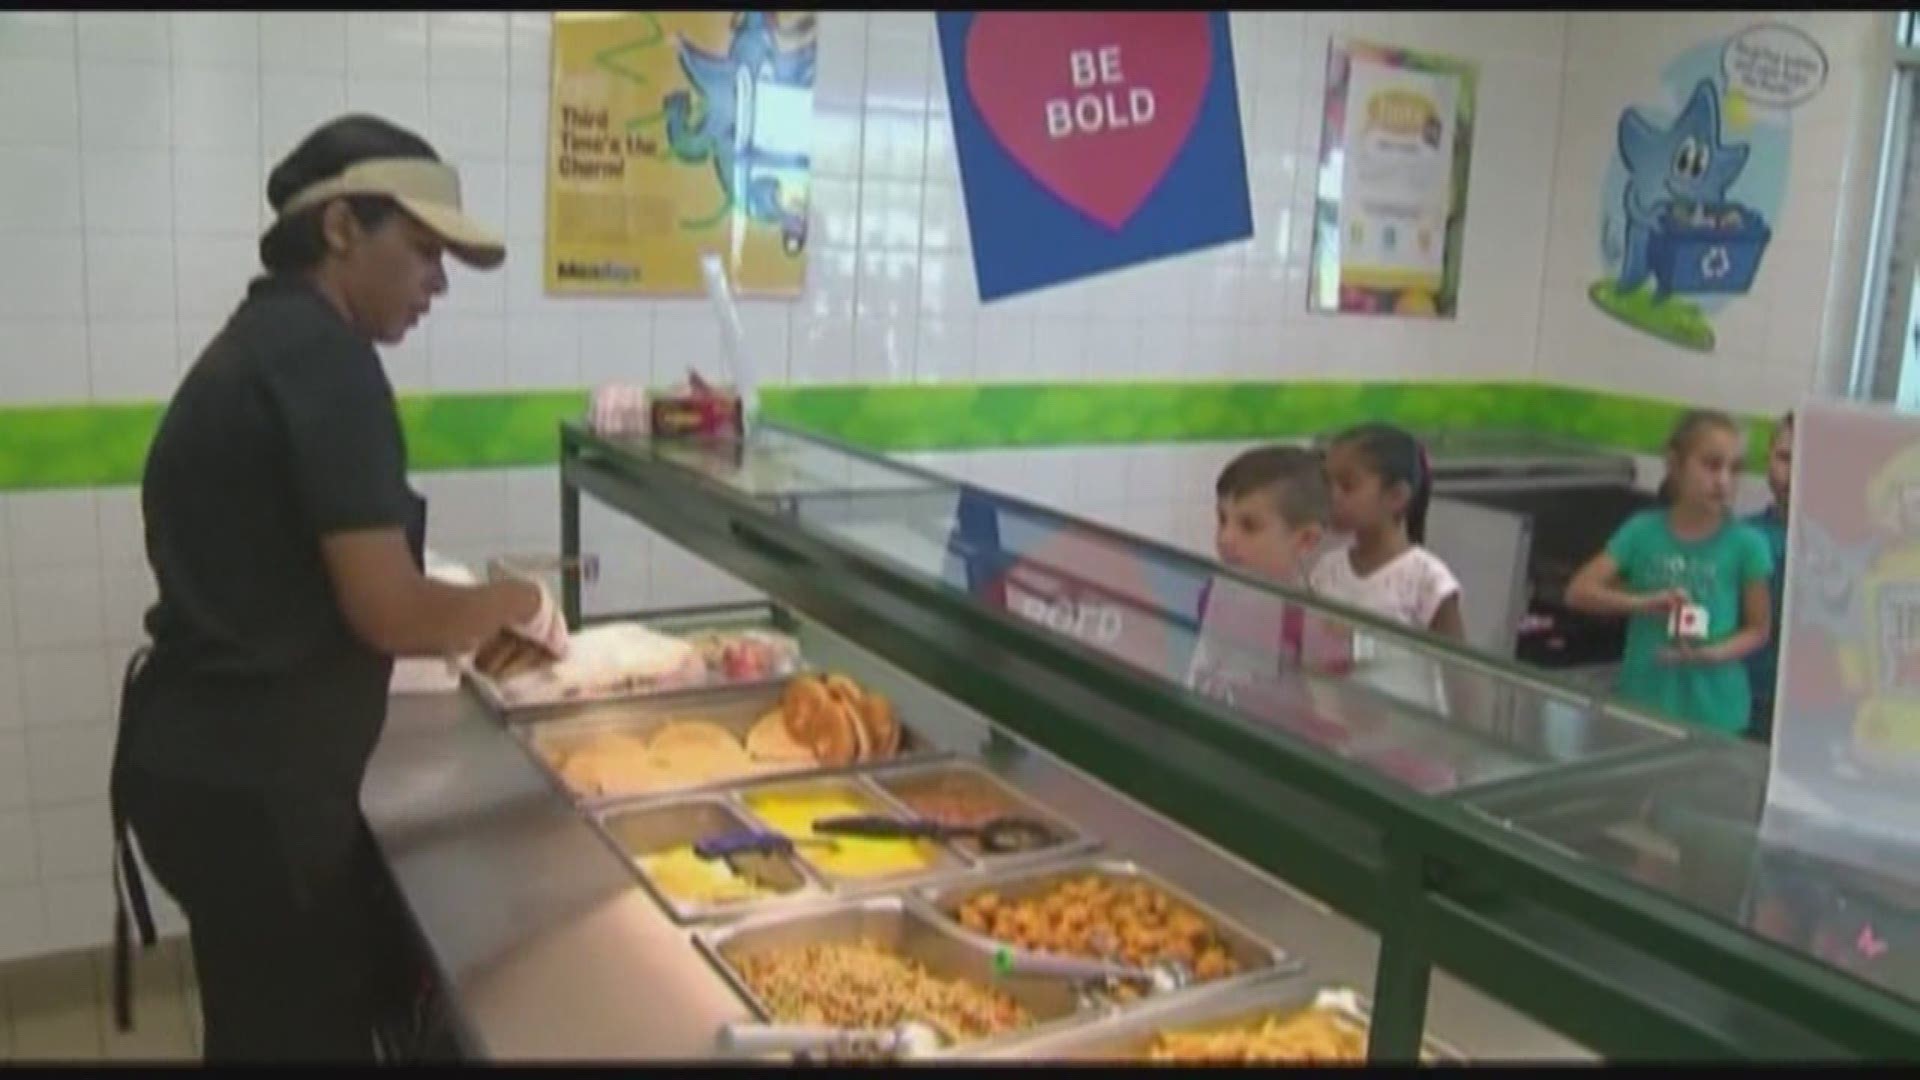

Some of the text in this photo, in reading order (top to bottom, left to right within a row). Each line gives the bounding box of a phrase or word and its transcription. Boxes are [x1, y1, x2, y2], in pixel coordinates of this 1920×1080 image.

[1070, 45, 1124, 88] BE
[562, 104, 609, 129] Third
[1046, 87, 1156, 138] BOLD
[626, 133, 658, 156] the
